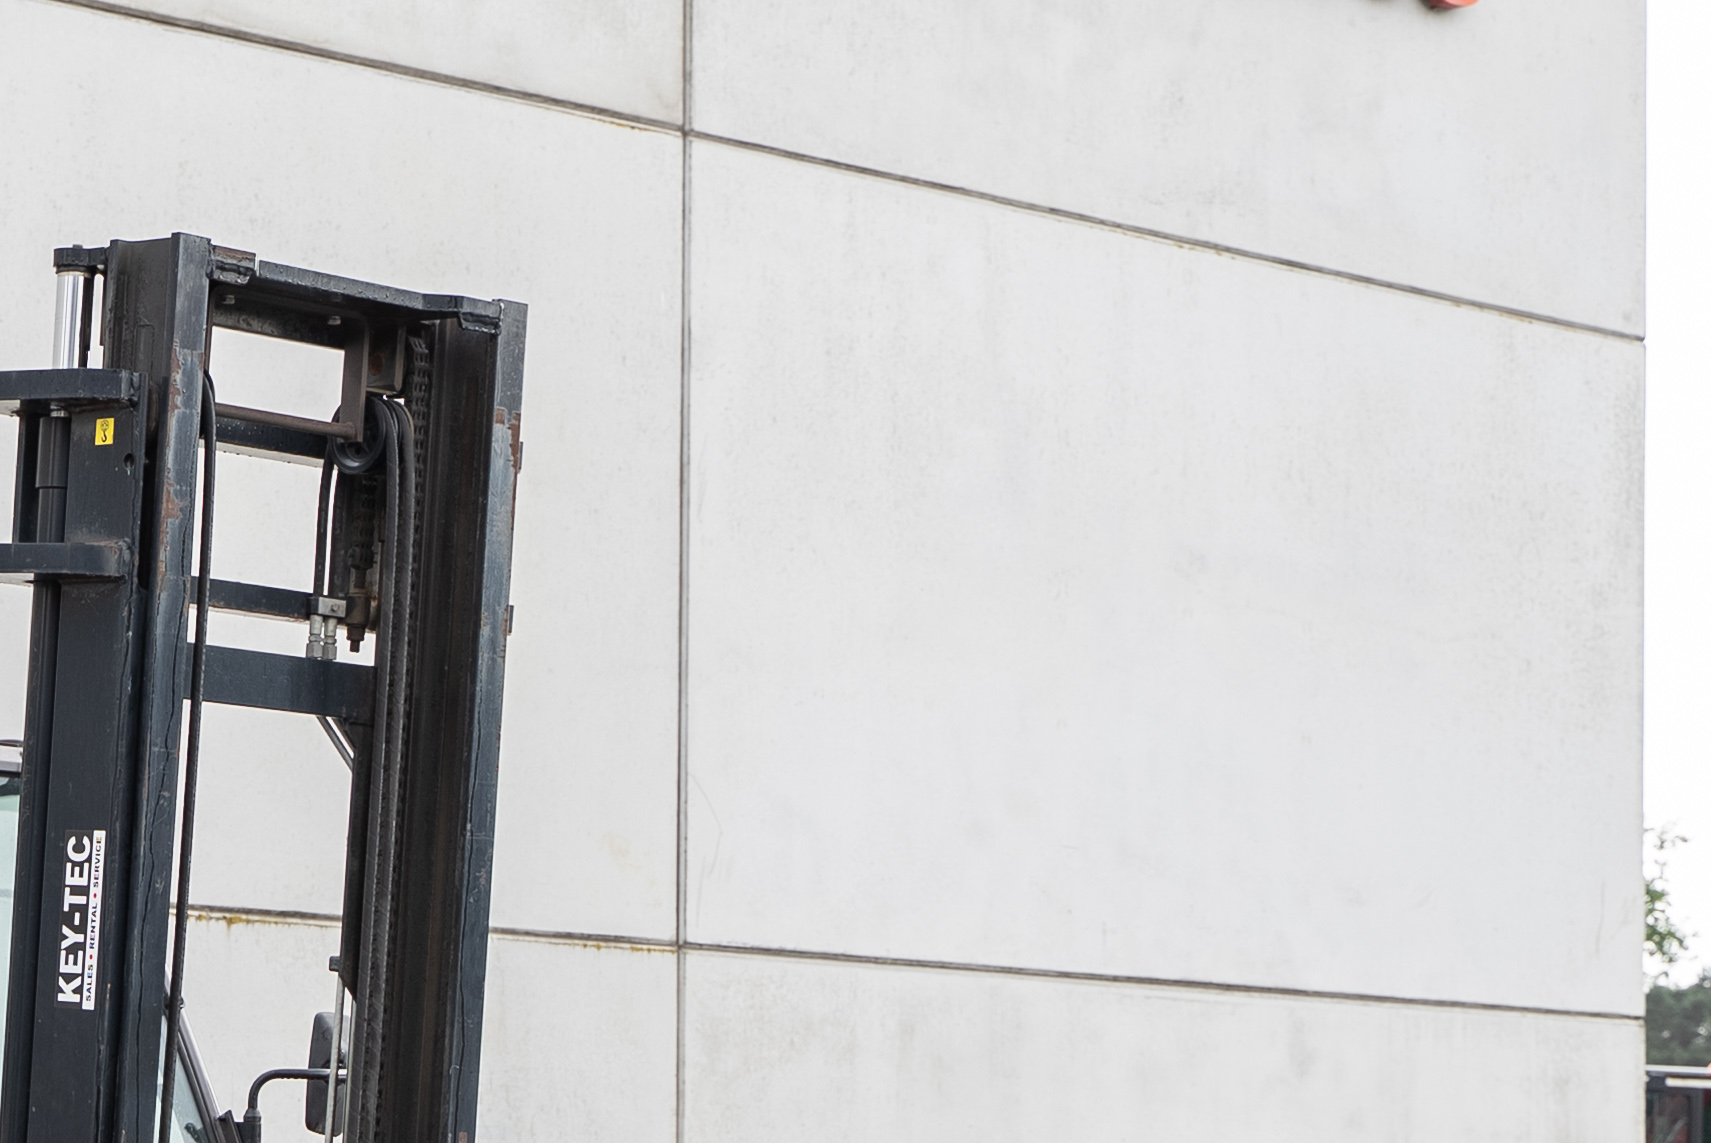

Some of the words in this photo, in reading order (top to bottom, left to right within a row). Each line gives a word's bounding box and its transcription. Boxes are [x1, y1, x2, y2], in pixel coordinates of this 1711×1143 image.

[93, 836, 102, 889] SERVICE
[57, 835, 91, 1003] KEY-TEC
[89, 902, 98, 950] RENTAL
[85, 963, 94, 1002] SALES
